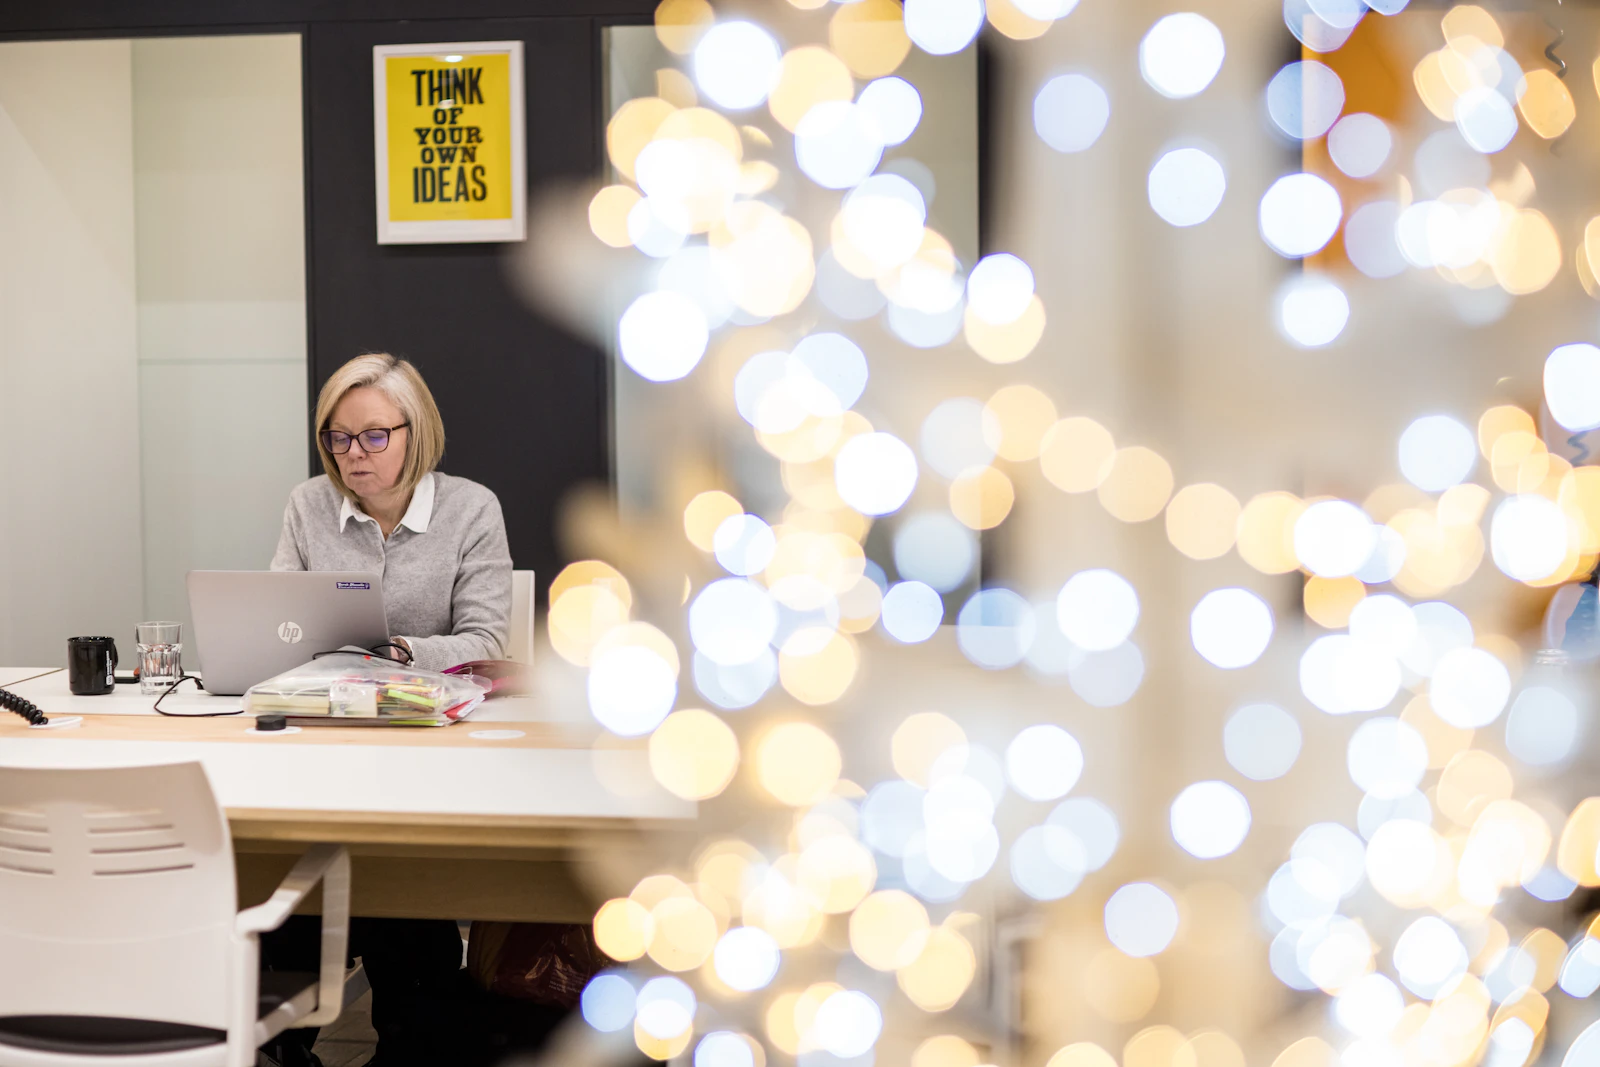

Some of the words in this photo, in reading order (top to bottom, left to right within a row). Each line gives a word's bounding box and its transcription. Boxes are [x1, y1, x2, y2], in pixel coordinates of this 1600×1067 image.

[411, 67, 484, 106] THINK
[433, 107, 463, 125] OF
[414, 126, 483, 145] YOUR
[421, 146, 477, 164] OWN
[413, 165, 487, 203] IDEAS
[281, 621, 300, 644] hp
